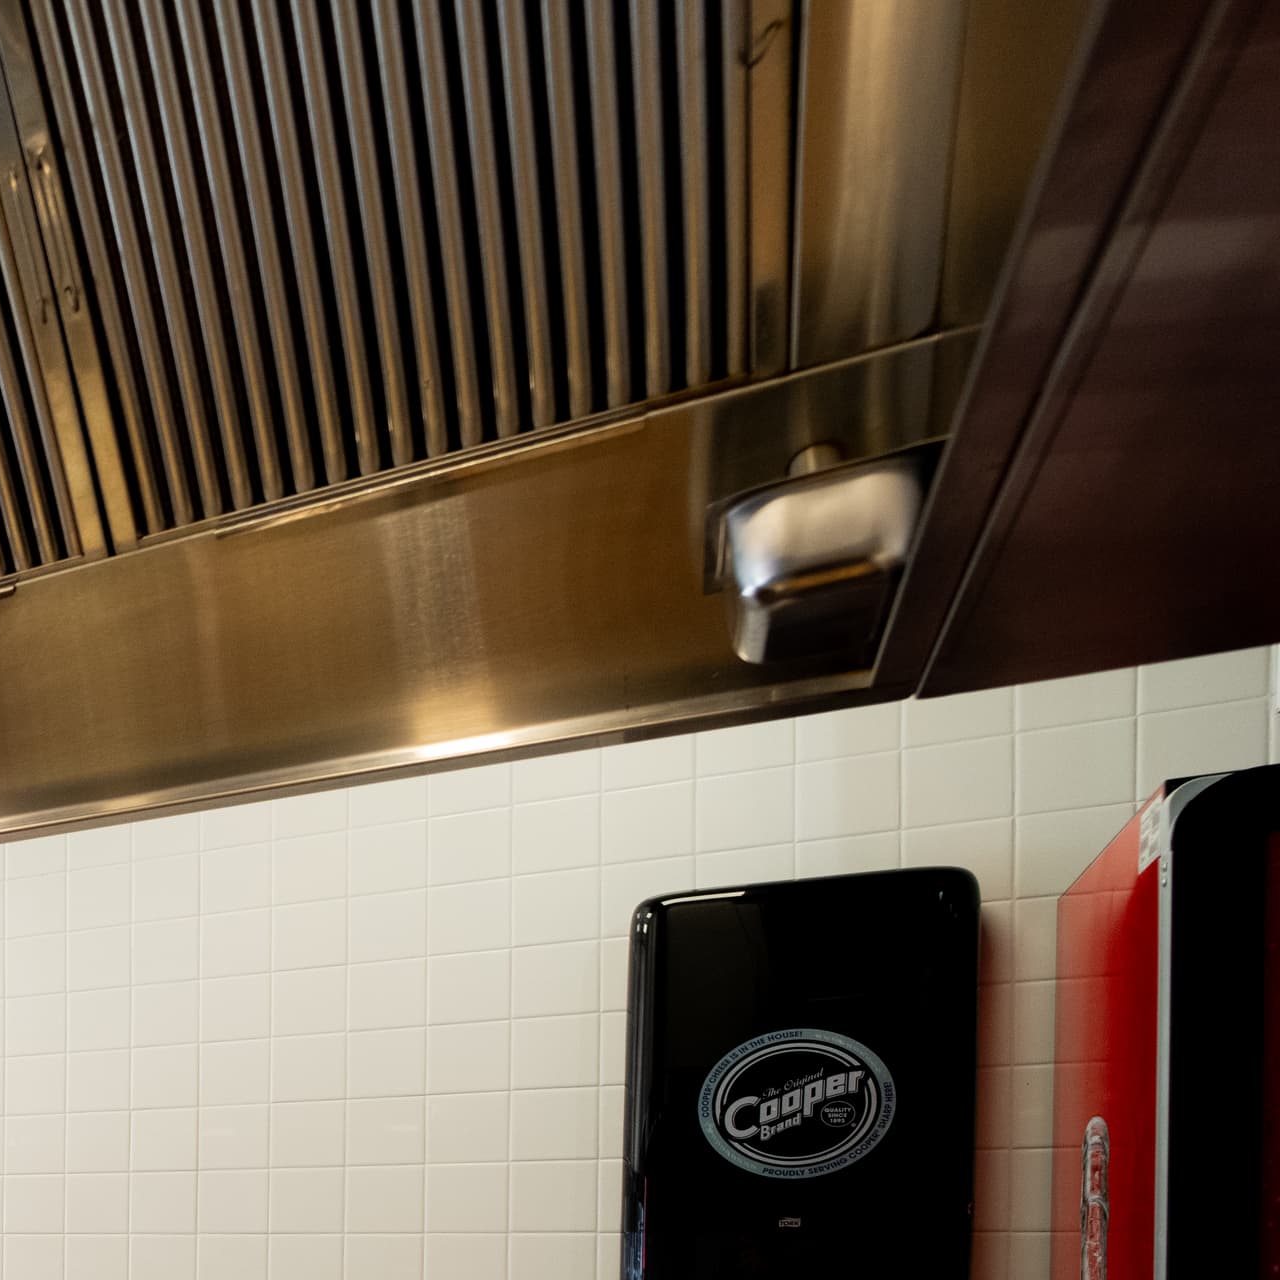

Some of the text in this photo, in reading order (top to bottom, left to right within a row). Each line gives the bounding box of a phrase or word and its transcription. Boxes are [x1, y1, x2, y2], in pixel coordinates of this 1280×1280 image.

[748, 1038, 766, 1048] THE
[767, 1031, 803, 1042] HOUSE!
[761, 1067, 824, 1099] The Original
[724, 1070, 866, 1140] Cooper
[759, 1112, 802, 1142] Brand
[761, 1167, 806, 1177] PROUDLY
[807, 1157, 848, 1175] SERVING
